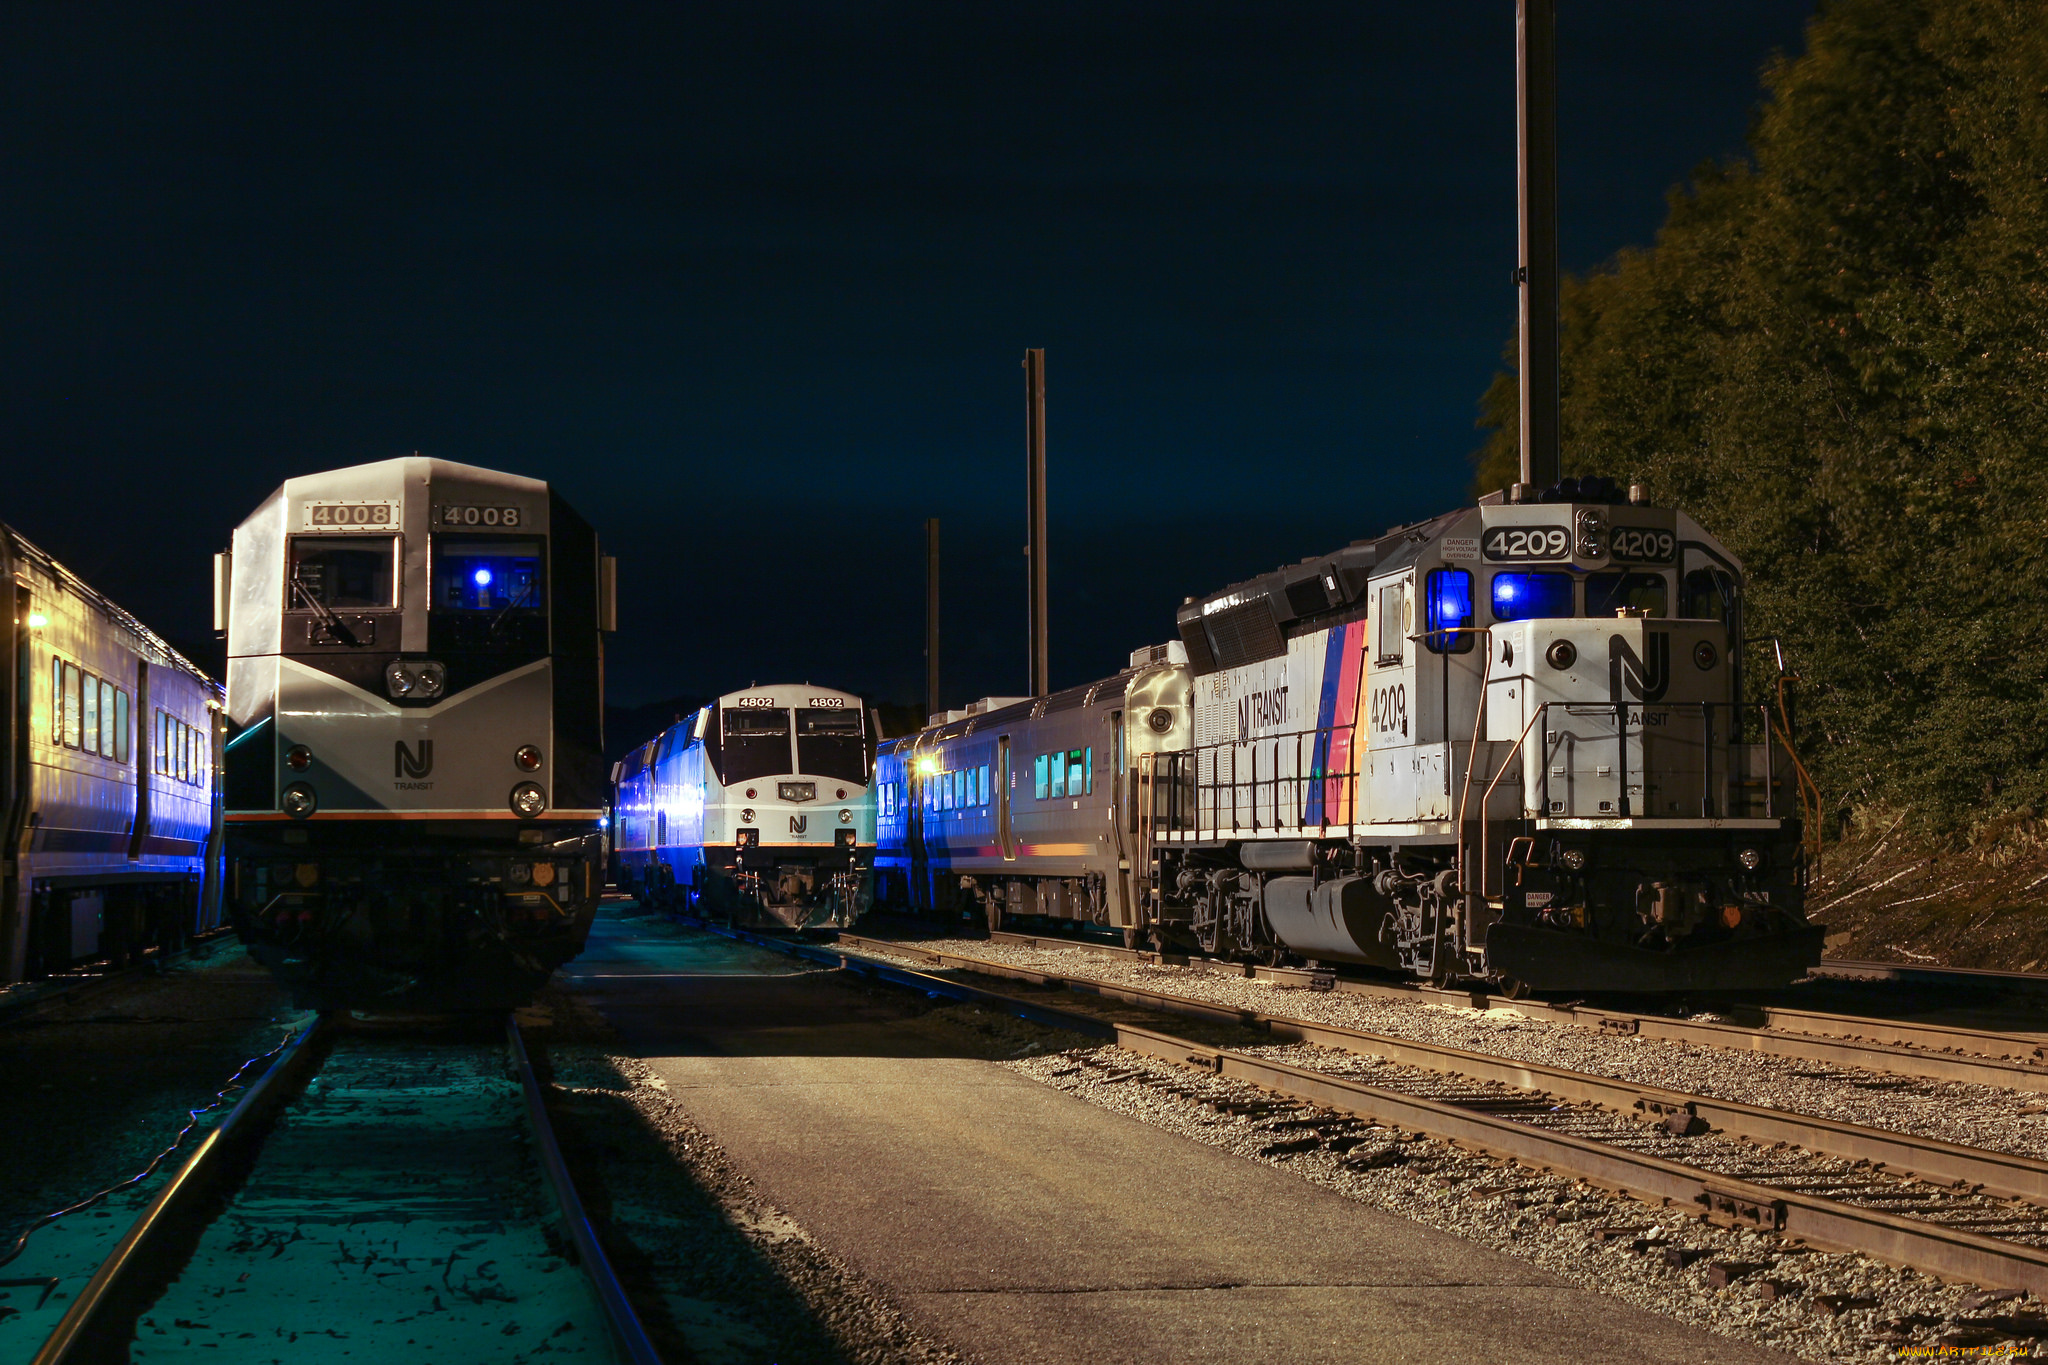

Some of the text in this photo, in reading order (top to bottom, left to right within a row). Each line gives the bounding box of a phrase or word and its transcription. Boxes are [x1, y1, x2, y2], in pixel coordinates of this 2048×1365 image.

[314, 506, 389, 524] 4008
[444, 507, 519, 526] 4008
[1486, 530, 1567, 556] 4209
[1612, 531, 1674, 558] 4209
[740, 698, 773, 707] 4802
[810, 698, 843, 707] 4802
[1251, 685, 1289, 729] TRANSIT
[1372, 682, 1408, 733] 4209
[1608, 711, 1669, 726] TANSIT
[395, 739, 433, 779] NJ
[393, 782, 435, 790] TRANSIT
[789, 815, 807, 834] NJ
